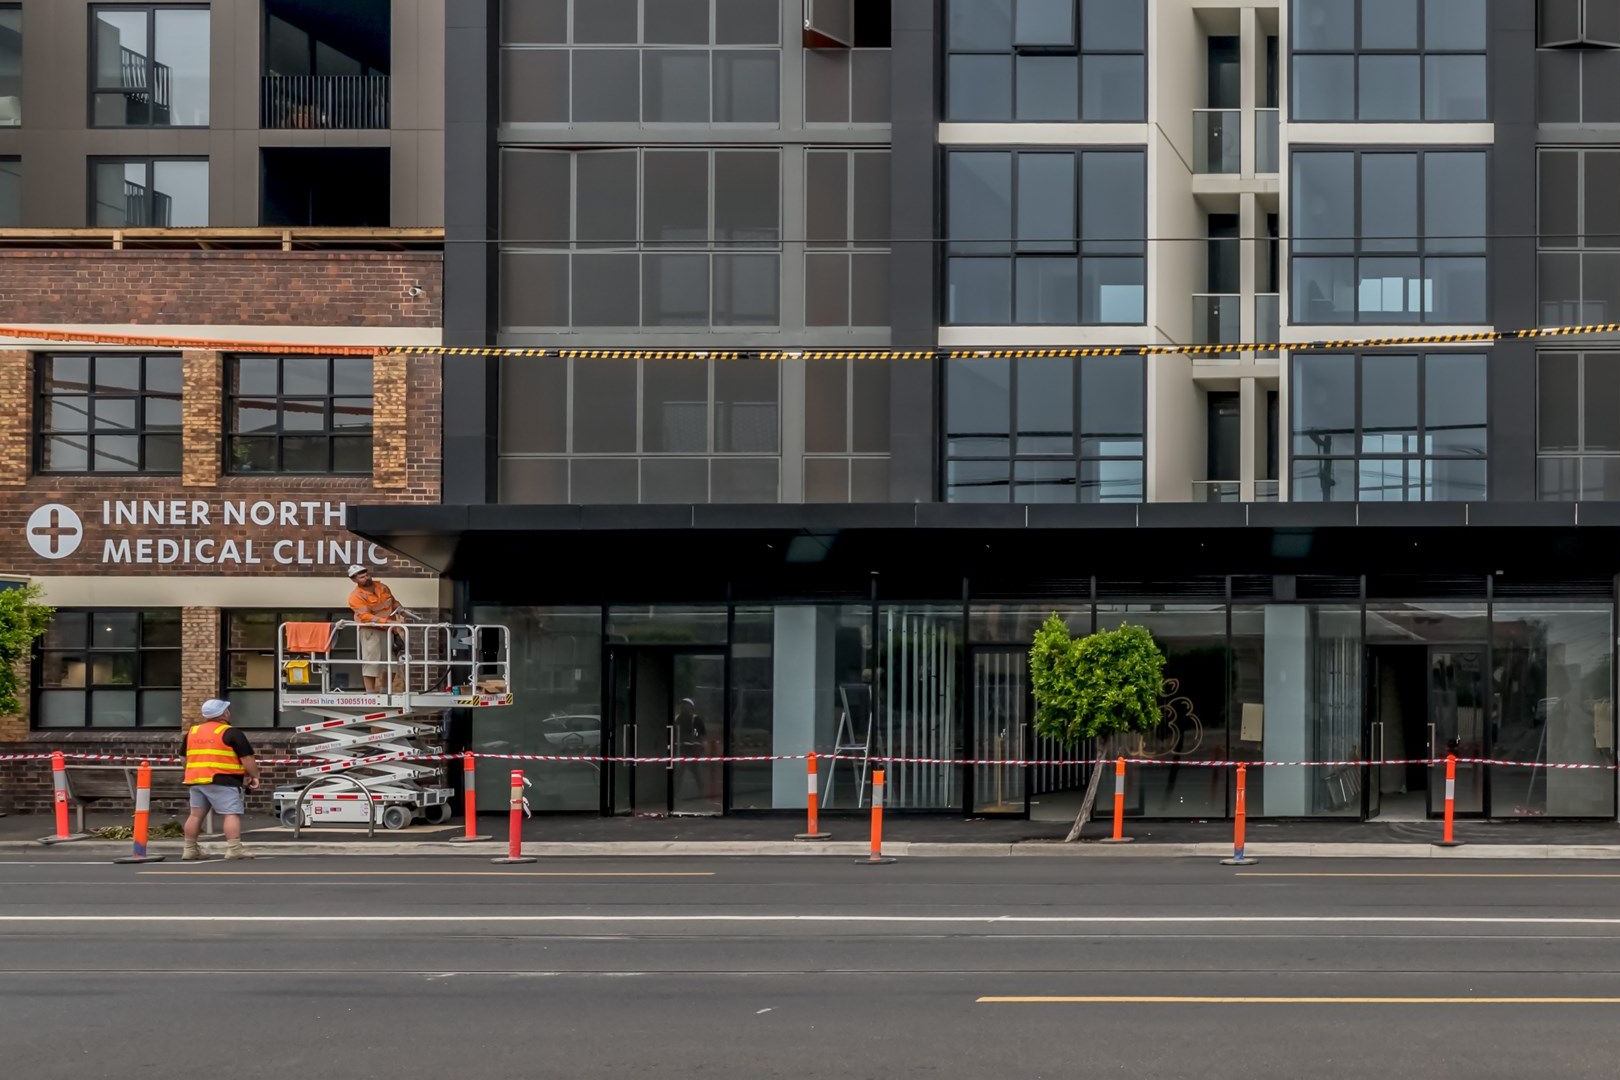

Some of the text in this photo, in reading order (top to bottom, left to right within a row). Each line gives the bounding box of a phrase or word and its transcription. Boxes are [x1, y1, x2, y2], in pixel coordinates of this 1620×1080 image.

[103, 500, 347, 526] INNER NORTH
[102, 538, 388, 565] MEDICAL CLINIC
[300, 697, 320, 705] alfasi
[321, 697, 335, 705] hire
